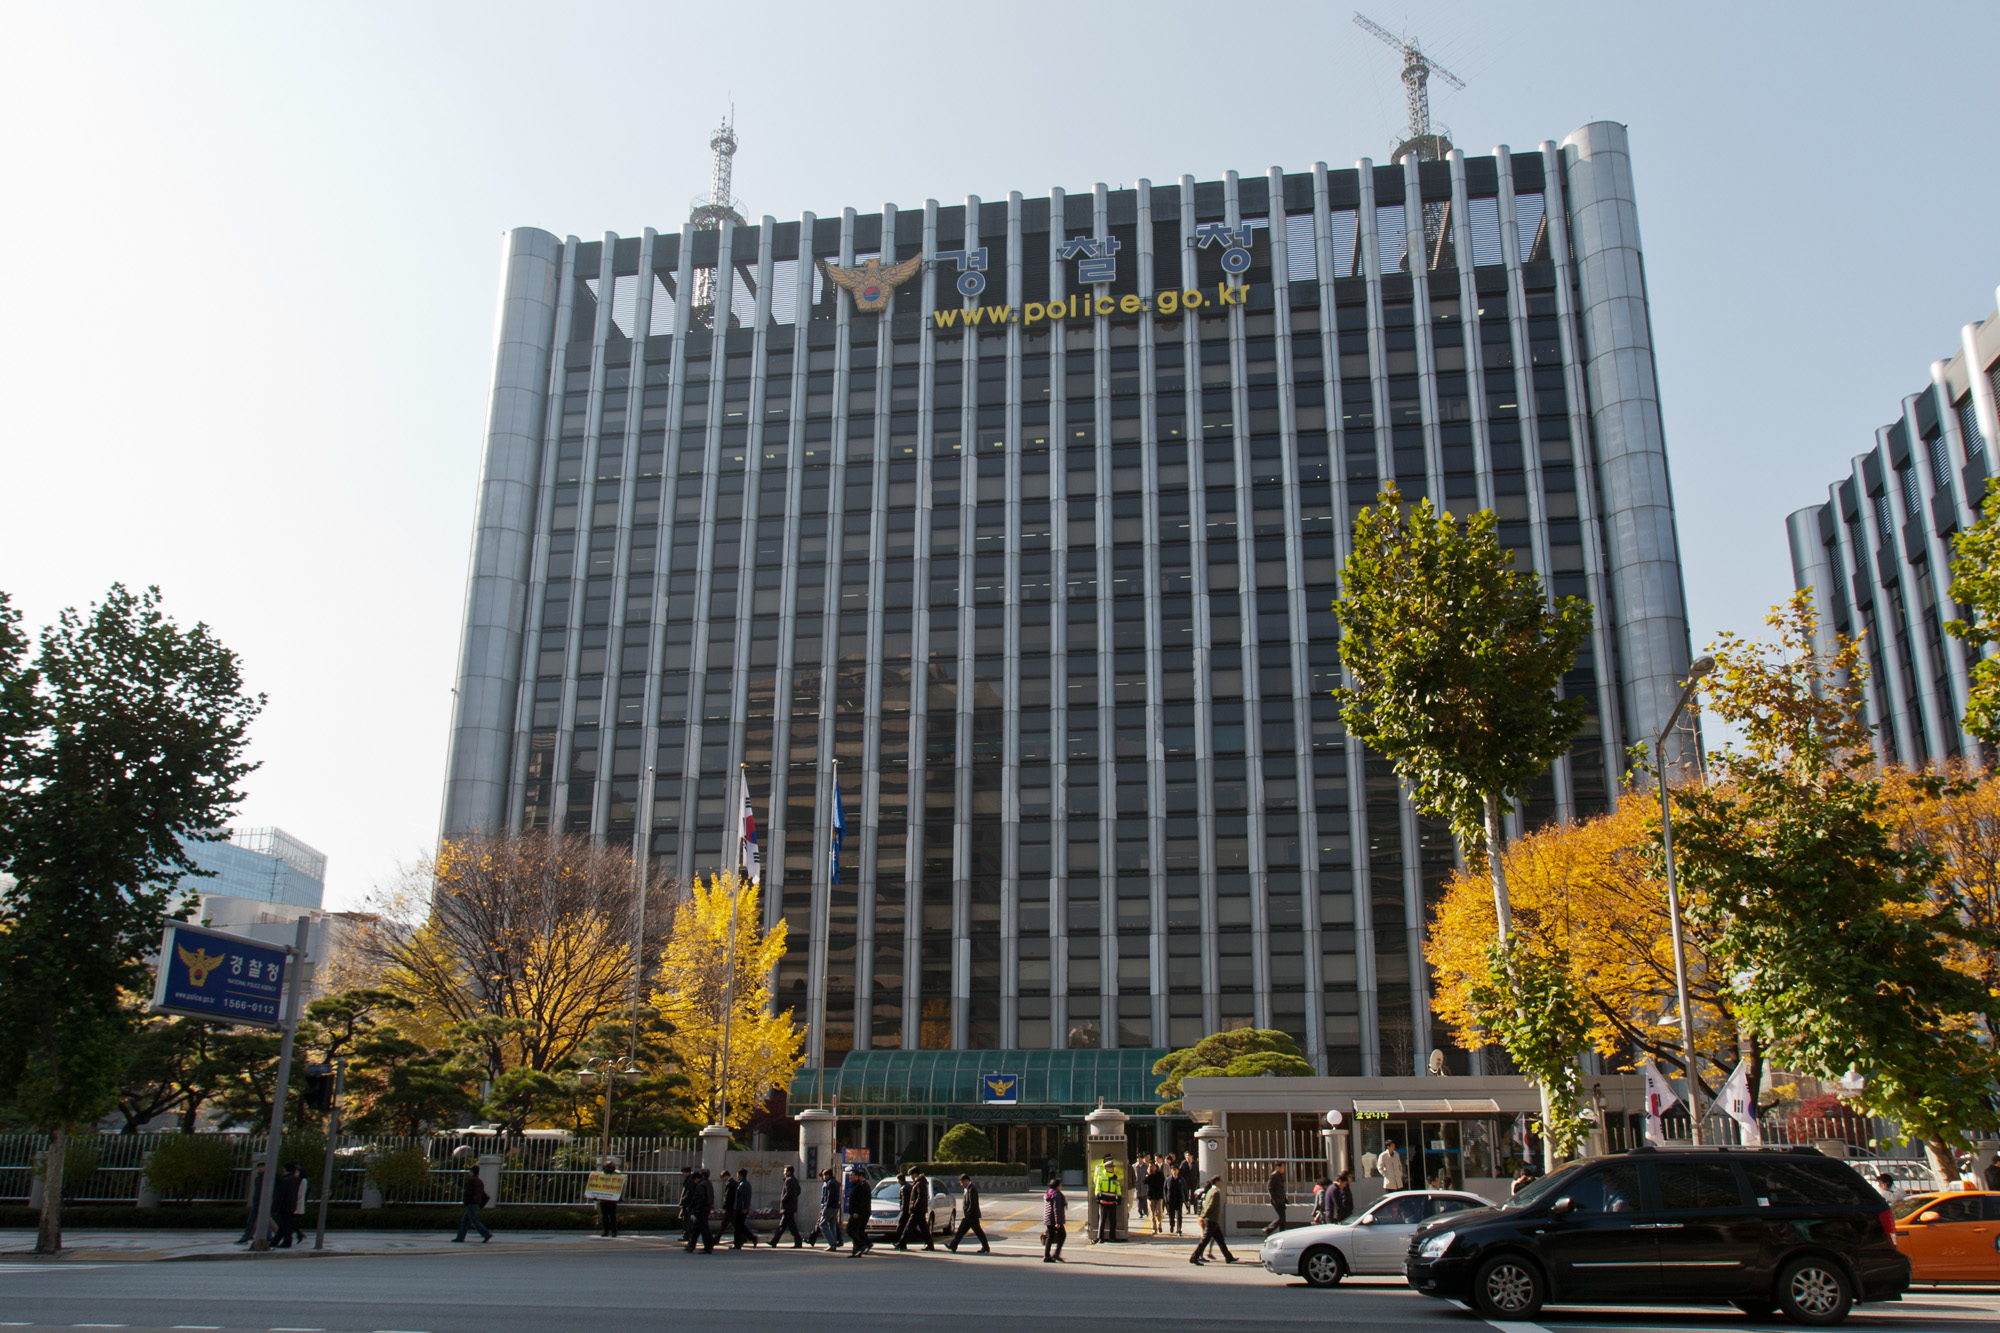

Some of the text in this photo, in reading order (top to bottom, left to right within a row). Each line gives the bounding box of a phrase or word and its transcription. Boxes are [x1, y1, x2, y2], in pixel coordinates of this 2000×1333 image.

[934, 283, 1249, 328] www.police.go.kr
[230, 956, 279, 982] 경찰청
[228, 978, 247, 987] NATIONAL
[247, 981, 261, 989] POLICE
[176, 992, 215, 1003] www.police.go.kr
[224, 999, 274, 1014] 1566-0112
